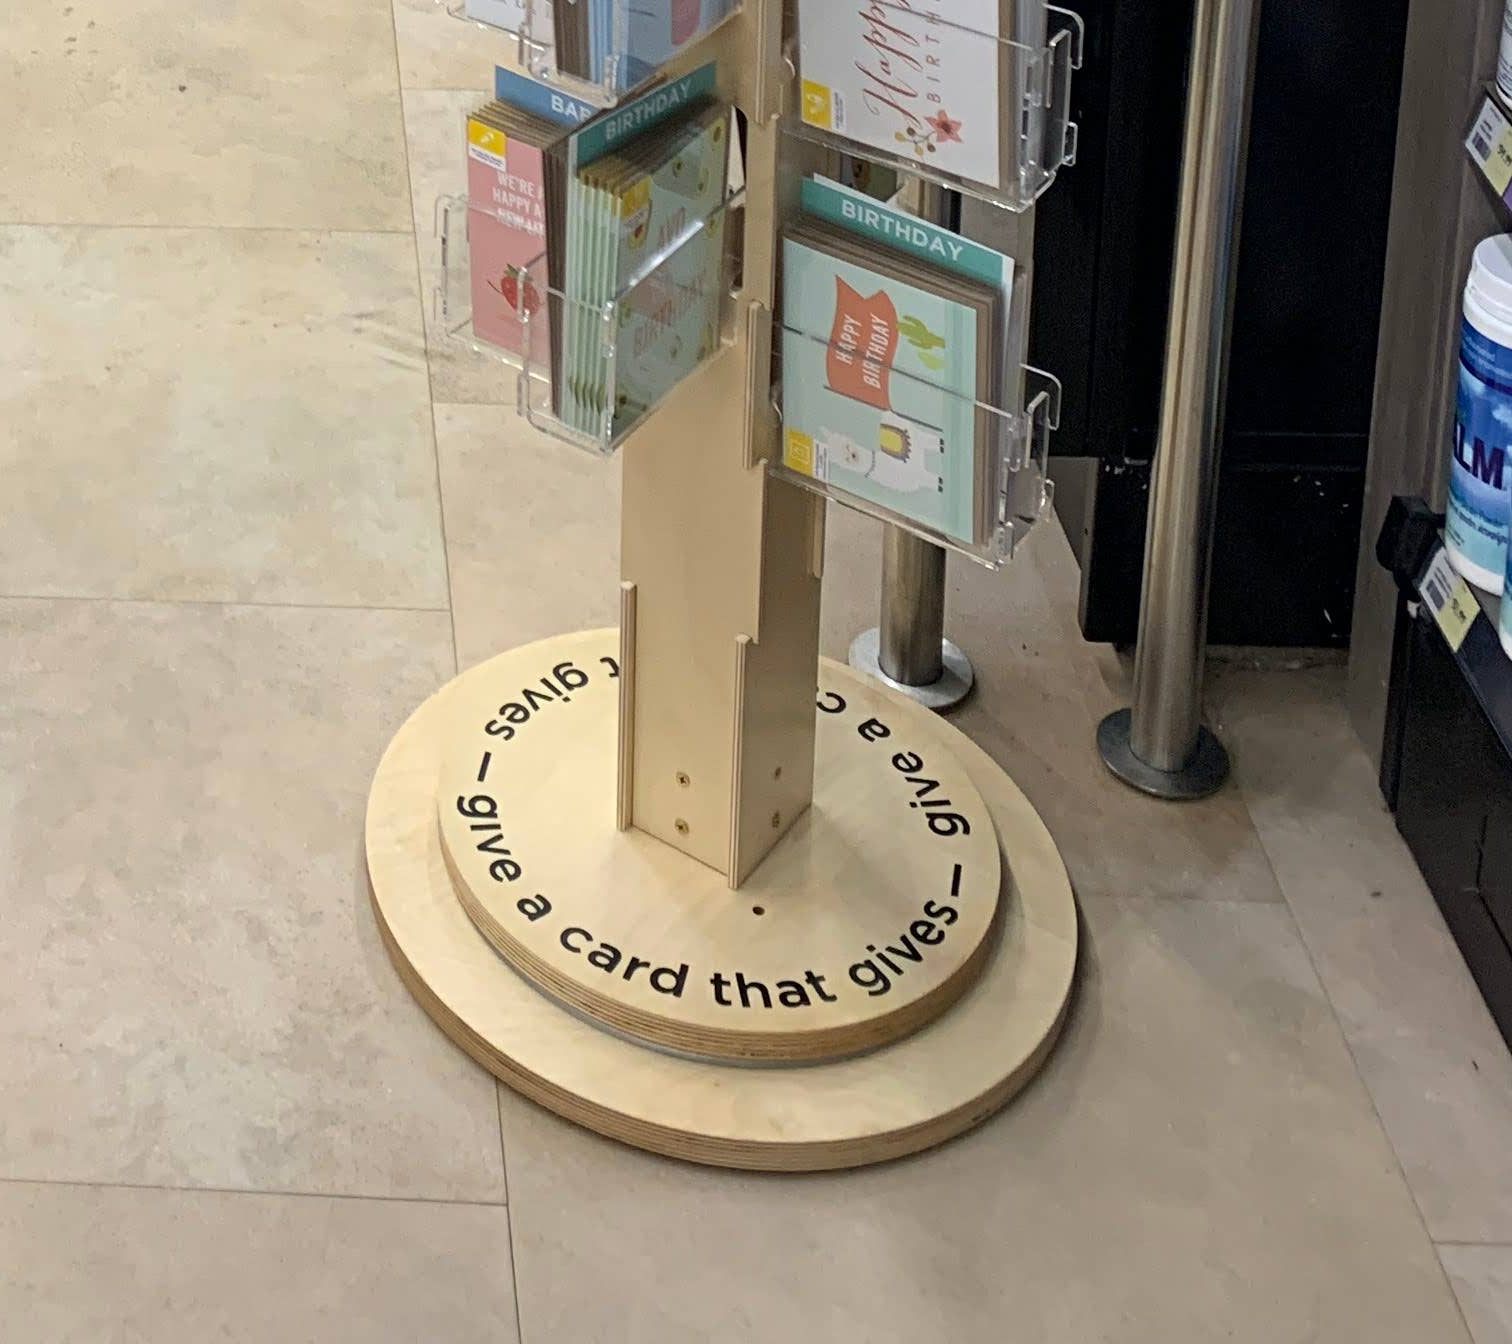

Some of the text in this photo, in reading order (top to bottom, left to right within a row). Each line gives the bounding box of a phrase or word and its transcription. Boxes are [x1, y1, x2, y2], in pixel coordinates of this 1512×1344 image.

[605, 79, 693, 141] BIRTHDAY
[492, 185, 531, 214] HAPPY
[841, 198, 964, 262] BIRTHDAY
[836, 314, 861, 365] HAPPY
[862, 312, 890, 389] BIRTHDAY
[485, 660, 589, 742] gives
[857, 717, 971, 838] a give
[456, 793, 960, 1009] give a card that gives
